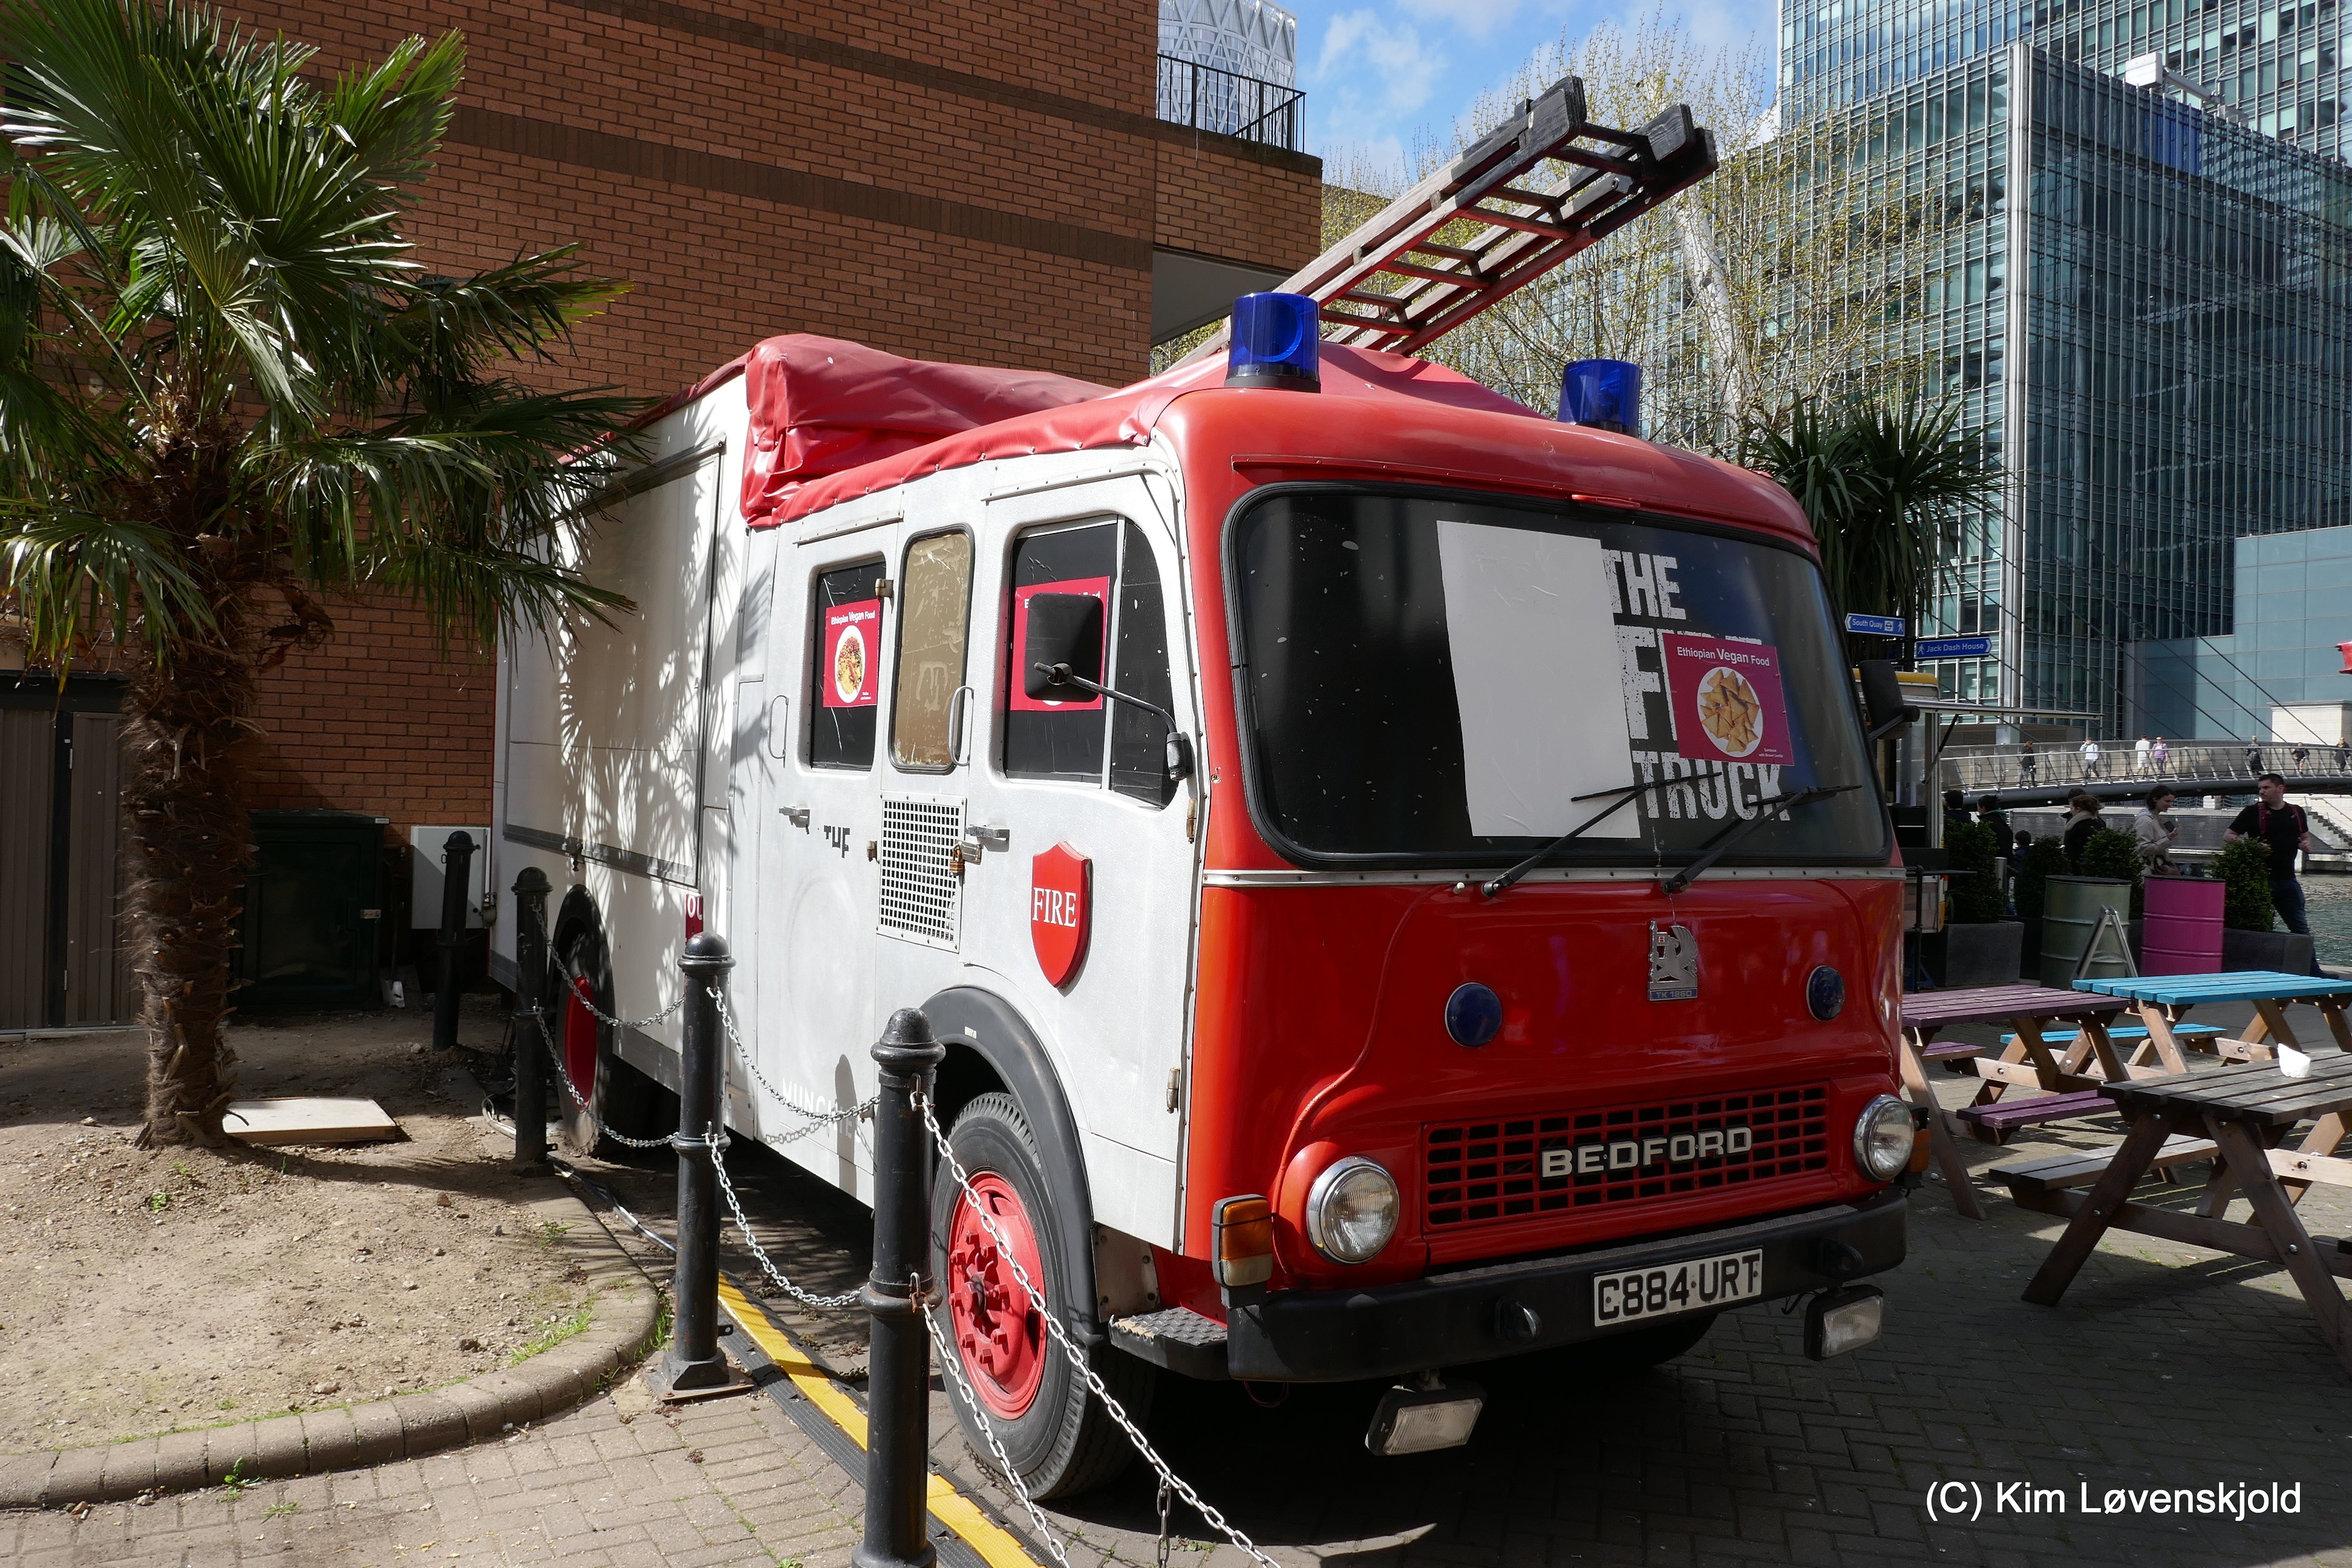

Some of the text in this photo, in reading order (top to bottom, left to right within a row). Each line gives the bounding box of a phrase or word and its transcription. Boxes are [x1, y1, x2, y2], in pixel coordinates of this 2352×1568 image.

[1601, 548, 1686, 620] THE
[848, 611, 865, 624] Vegan
[865, 609, 875, 620] Food
[1852, 617, 1883, 630] South Quay
[1677, 646, 1770, 666] Ethiopian Vegan Food
[1926, 641, 1984, 653] Jack Dash House
[1632, 750, 1791, 821] TRUCK
[1032, 887, 1076, 927] FIRE
[1541, 1126, 1752, 1178] BEDFORD
[1597, 1253, 1760, 1321] C884 URT
